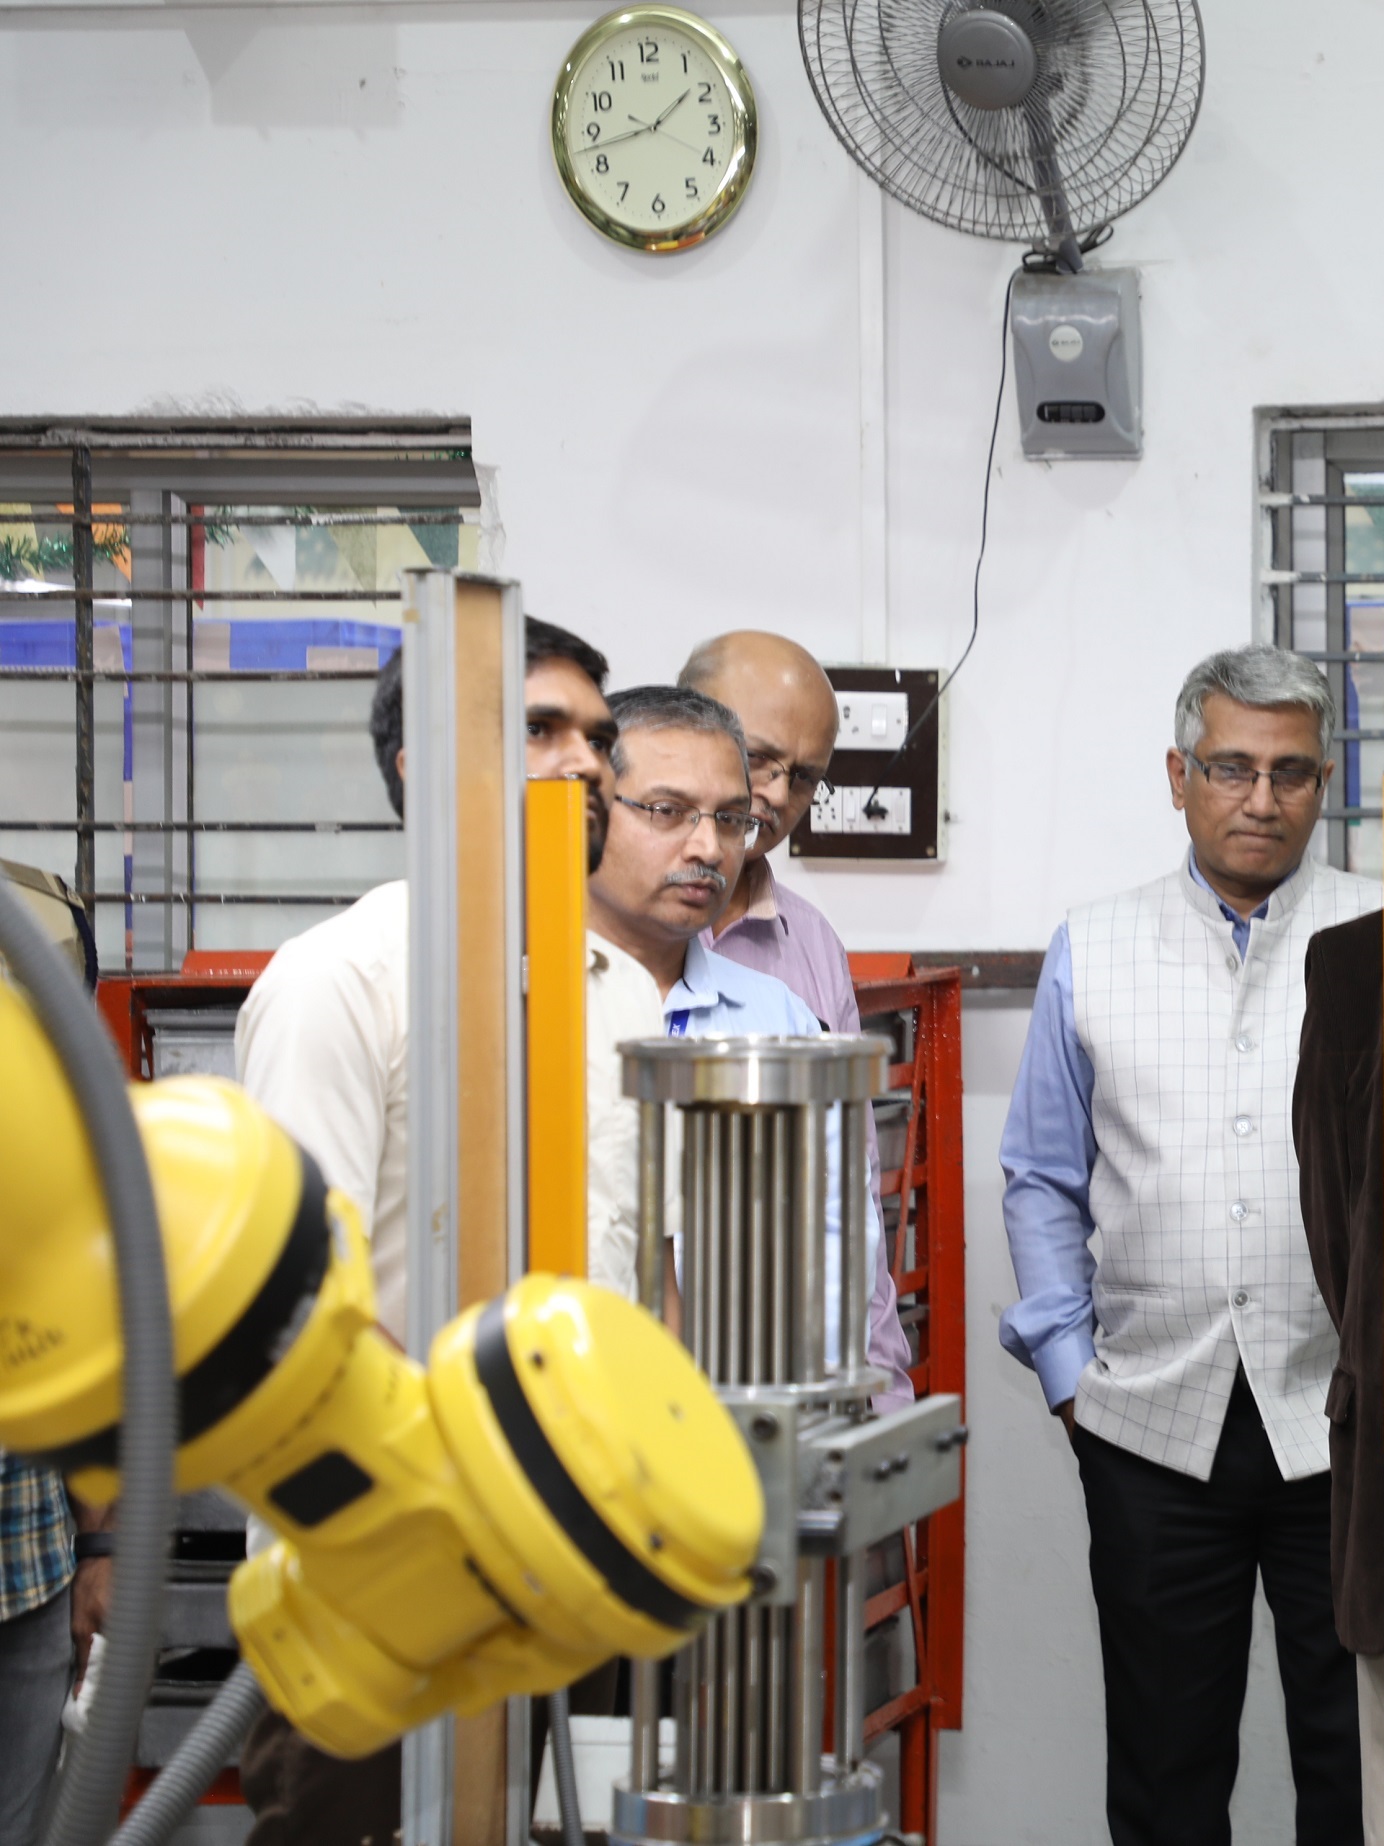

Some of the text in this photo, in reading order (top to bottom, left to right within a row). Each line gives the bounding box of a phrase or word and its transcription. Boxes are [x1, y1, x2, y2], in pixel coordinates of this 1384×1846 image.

[637, 42, 659, 63] 12
[610, 61, 625, 81] 11
[681, 53, 688, 74] 1
[591, 91, 612, 112] 10
[698, 82, 712, 103] 2
[586, 122, 601, 142] 9
[708, 114, 721, 135] 3
[595, 154, 610, 174] 8
[702, 146, 716, 167] 4
[617, 182, 630, 202] 7
[685, 178, 698, 198] 5
[651, 194, 666, 214] 6
